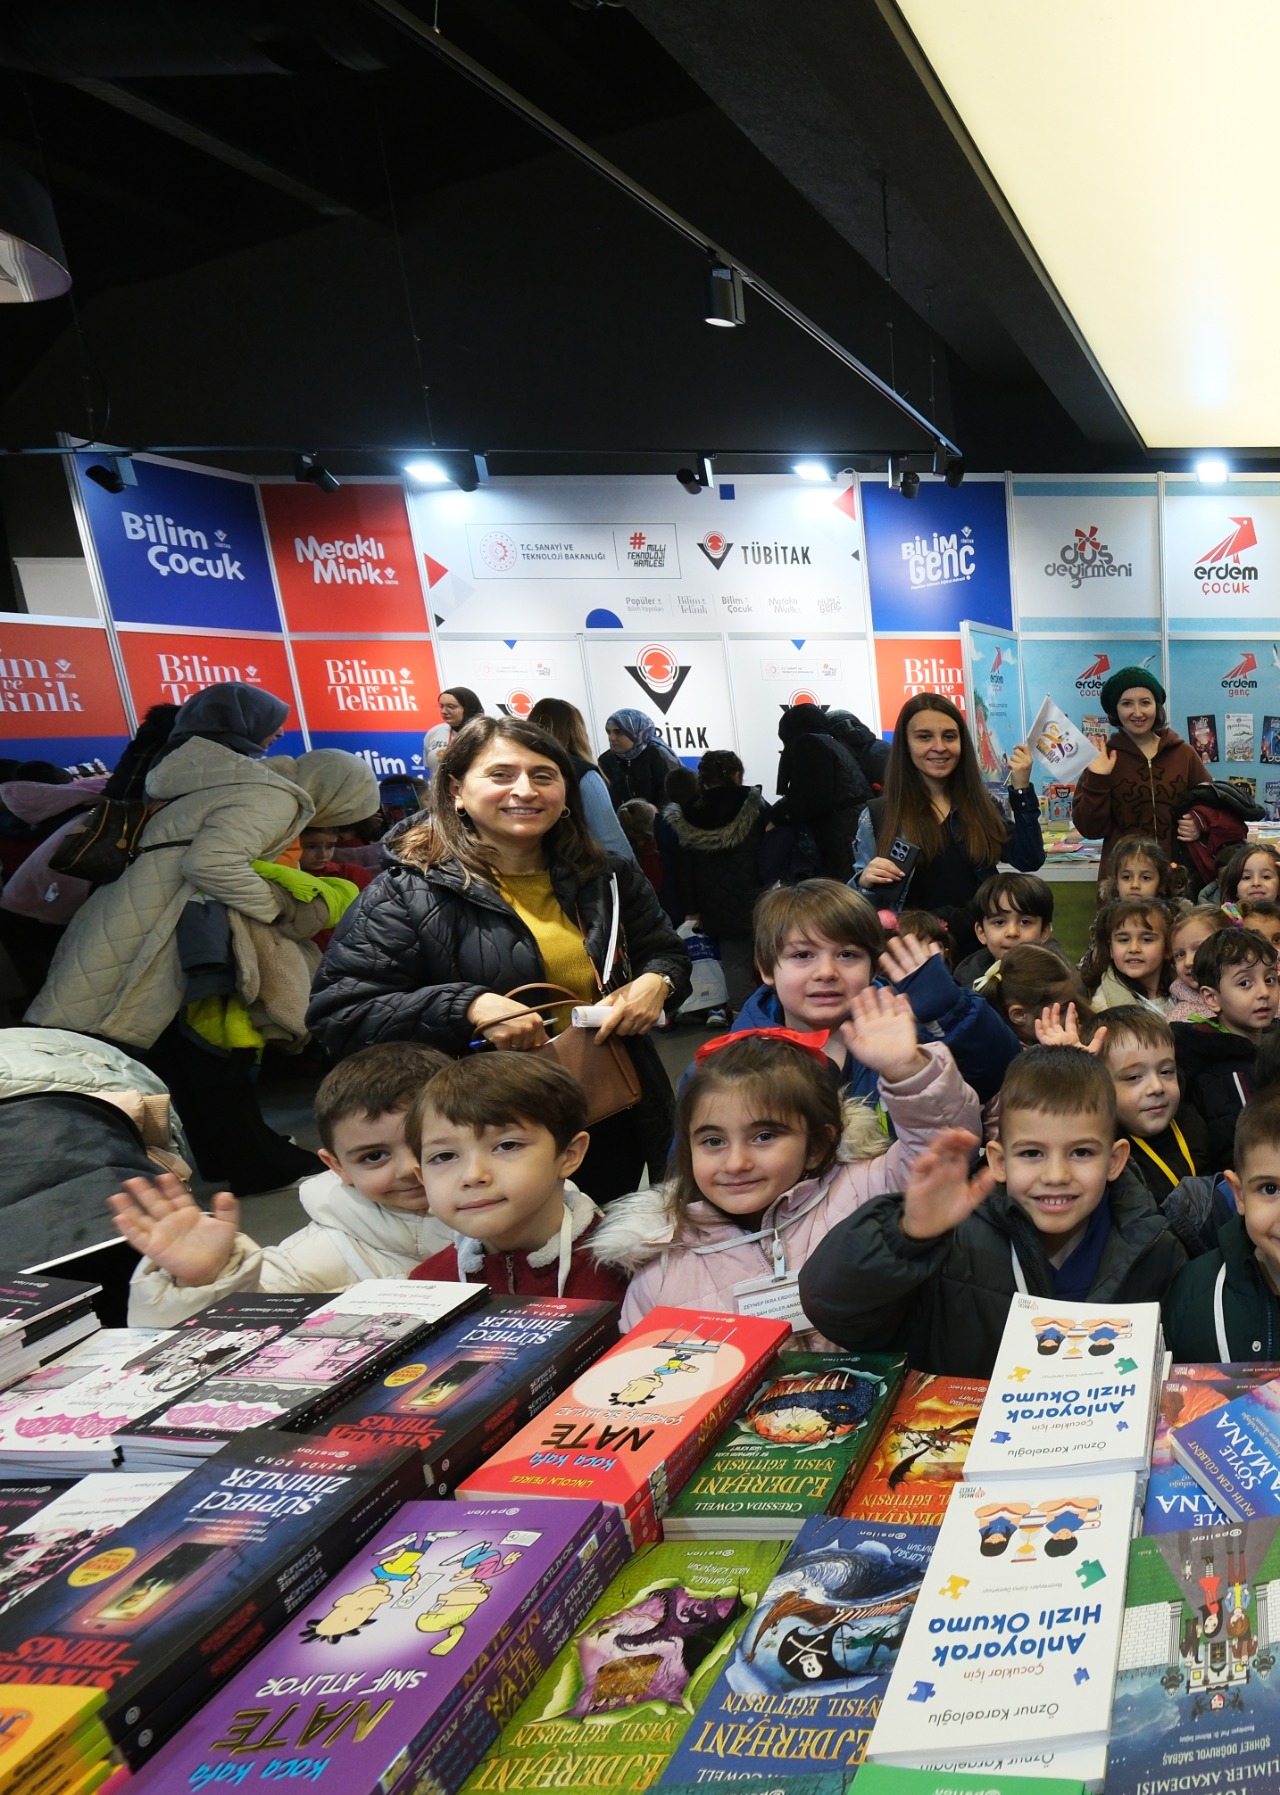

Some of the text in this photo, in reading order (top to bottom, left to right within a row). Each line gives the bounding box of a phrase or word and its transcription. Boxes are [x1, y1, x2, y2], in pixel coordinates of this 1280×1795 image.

[120, 511, 208, 550] Bilim
[294, 533, 385, 563] Meraklı
[522, 551, 606, 560] TEKNOLOJİ BAKANLIĞI
[563, 543, 574, 551] VE
[740, 540, 812, 566] TÜBİTAK
[147, 545, 246, 581] Çocuk
[313, 559, 384, 585] Minik
[1194, 562, 1259, 580] erdem
[721, 595, 743, 605] Bilim
[727, 605, 753, 614] Çocuk
[156, 653, 241, 683] Bilim
[325, 659, 397, 685] Bilim
[1221, 678, 1257, 688] erdem
[1228, 689, 1250, 697] genç
[327, 686, 419, 712] Teknik
[459, 1328, 553, 1346] ŞÜPHECİ
[476, 1316, 572, 1333] ZİHİNLER
[1001, 1389, 1080, 1405] Okuma
[1086, 1383, 1137, 1400] Hızlı
[357, 1415, 437, 1434] THINGS
[554, 1406, 602, 1419] HAYLAZ
[1005, 1401, 1125, 1424] Anlayarak
[540, 1423, 655, 1453] NATE
[1031, 1419, 1094, 1433] Çocuklar İçin
[1007, 1441, 1107, 1458] Öznur Karaeloğlu
[254, 1455, 358, 1473] GWENDA BOND
[711, 1458, 837, 1474] NASIL EĞİTİRSİN
[1218, 1444, 1262, 1492] SÖYLE
[219, 1468, 352, 1498] ZİHİNLER
[689, 1472, 832, 1498] EJDERHANI
[1187, 1440, 1256, 1518] FATİH CEM GÜLBENT
[188, 1491, 322, 1519] ŞÜPHECİ
[694, 1500, 803, 1513] CRESSIDA COWELL
[861, 1493, 933, 1508] EĞİTİRSİN
[541, 1542, 575, 1586] ATLIYOR
[928, 1603, 1102, 1636] Hızlı Okuma
[16, 1637, 133, 1664] THINGS
[931, 1632, 1087, 1668] Anlayarak
[255, 1668, 429, 1698] SINIF ATLIYOR
[962, 1662, 1045, 1684] Çocuklar İçin
[718, 1691, 882, 1721] NASIL EĞİTİRSİN
[928, 1703, 1060, 1727] Öznur Karaeloğlu
[208, 1698, 396, 1757] NATE
[507, 1718, 679, 1749] NASIL EĞİTİRSİN
[689, 1717, 875, 1766] EJDERHANI
[1162, 1735, 1272, 1766] ŞÖHRET DOĞRUYOL SAĞBAŞ
[472, 1749, 671, 1793] EJDERHANI
